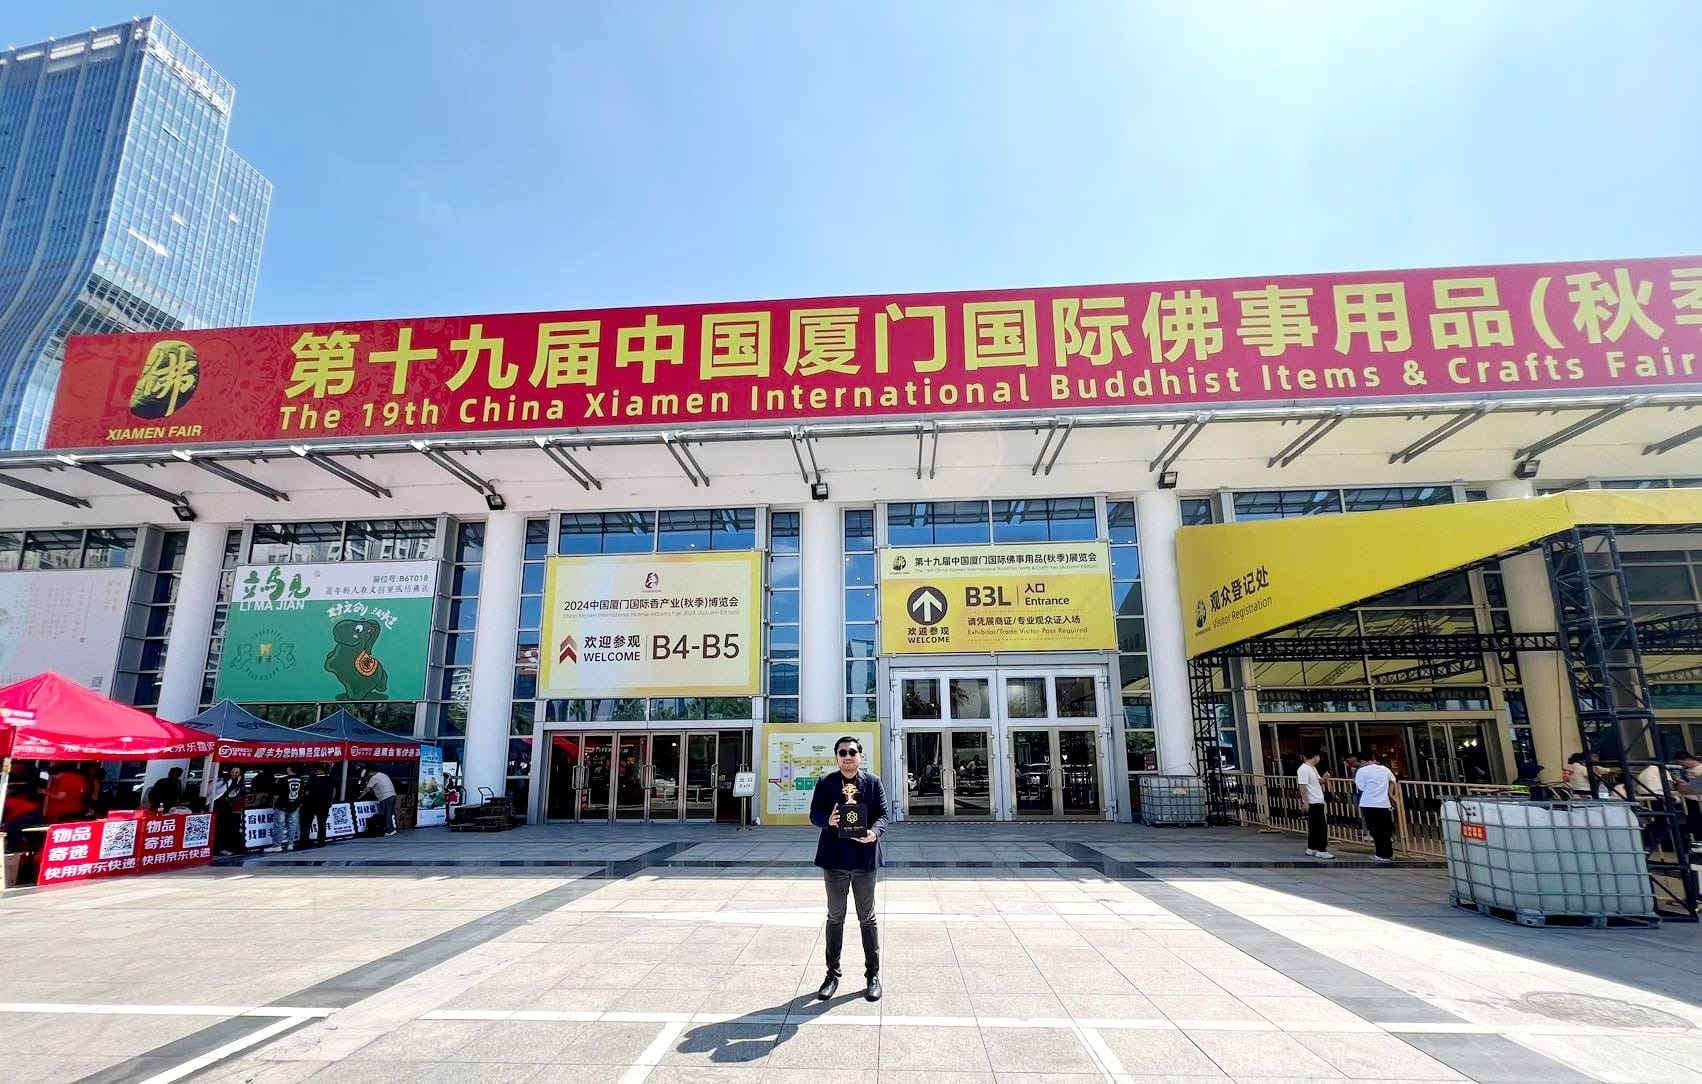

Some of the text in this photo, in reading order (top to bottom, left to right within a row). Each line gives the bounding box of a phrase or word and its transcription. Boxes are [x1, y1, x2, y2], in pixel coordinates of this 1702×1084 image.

[280, 347, 1695, 431] The 19th China Xiamen International Buddhist Items & Crafts Fair
[105, 425, 202, 441] XIAMEN FAIR
[914, 552, 1097, 568] 第十九届中国厦门国际佛事用品(秋季)展览会
[965, 585, 1012, 607] B3L
[1024, 583, 1045, 594] 入口
[1209, 565, 1270, 613] 观众登记处
[240, 600, 305, 611] LI MA JIAN
[563, 596, 740, 612] 2024中国厦门国际香产业(秋季)博览会
[1025, 596, 1070, 606] Entrance
[1212, 596, 1273, 629] Visitor Registration
[967, 615, 1081, 627] 请凭展商证/专业观众证入场
[907, 626, 950, 636] 欢迎参观
[967, 626, 1089, 636] Exhibitor/Trade Visitor Pass Required
[584, 634, 641, 649] 欢迎参观
[653, 633, 740, 660] B4-B5
[907, 636, 950, 644] WELCOME
[583, 651, 641, 662] WELCOME
[146, 818, 176, 833] 物品
[51, 826, 92, 843] 物品
[144, 835, 174, 850] 寄递
[47, 844, 89, 862] 寄递
[142, 847, 211, 866] 快用京东快递
[44, 858, 137, 881] 快用京东快递
